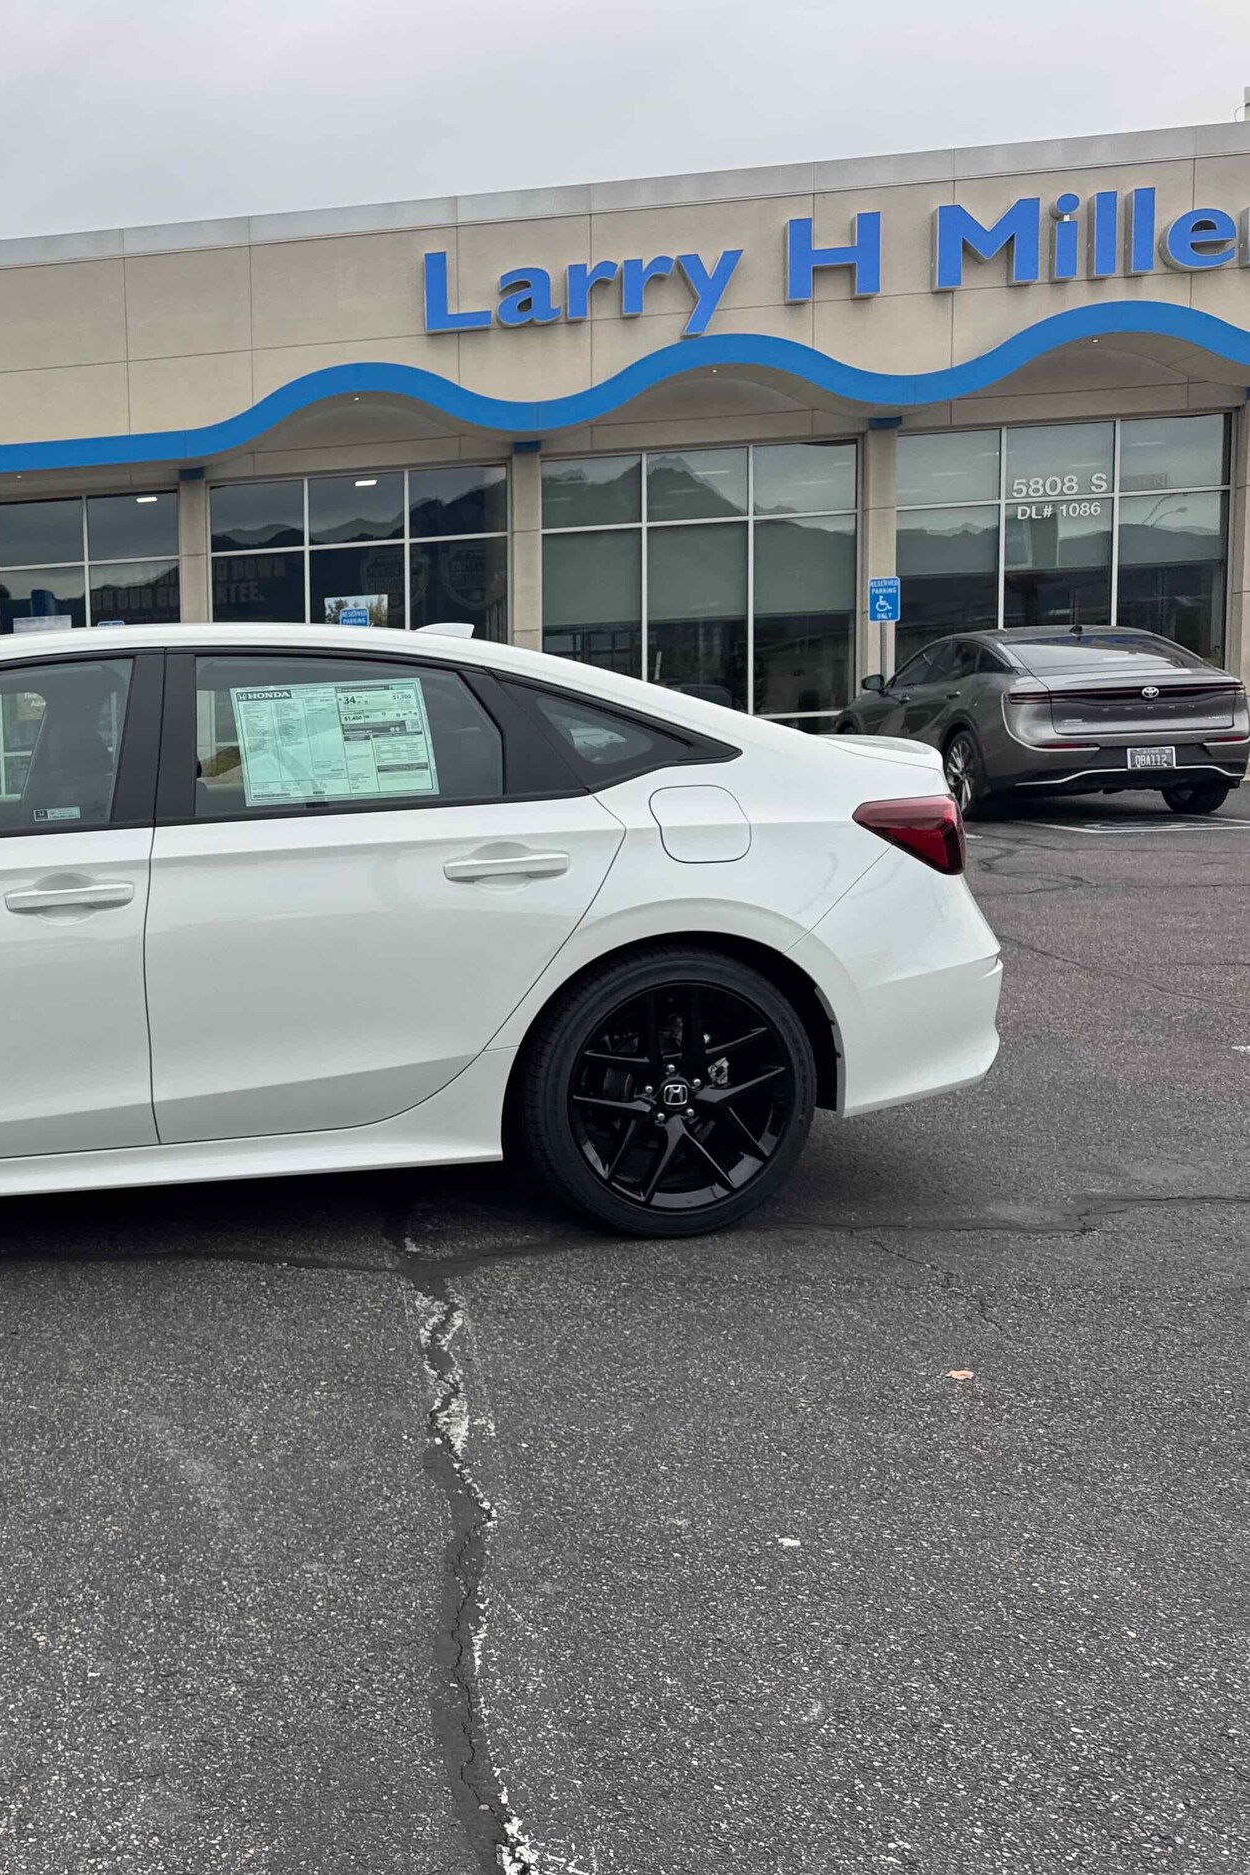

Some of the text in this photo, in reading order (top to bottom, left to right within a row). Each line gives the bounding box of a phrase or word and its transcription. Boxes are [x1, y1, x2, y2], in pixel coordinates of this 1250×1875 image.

[423, 186, 1239, 338] Larry H Mille
[1012, 475, 1079, 498] 5808
[1090, 473, 1108, 493] S
[1017, 502, 1101, 520] DL# 1086
[871, 587, 897, 595] PARKING
[248, 691, 290, 699] HONDA
[343, 696, 356, 704] 34
